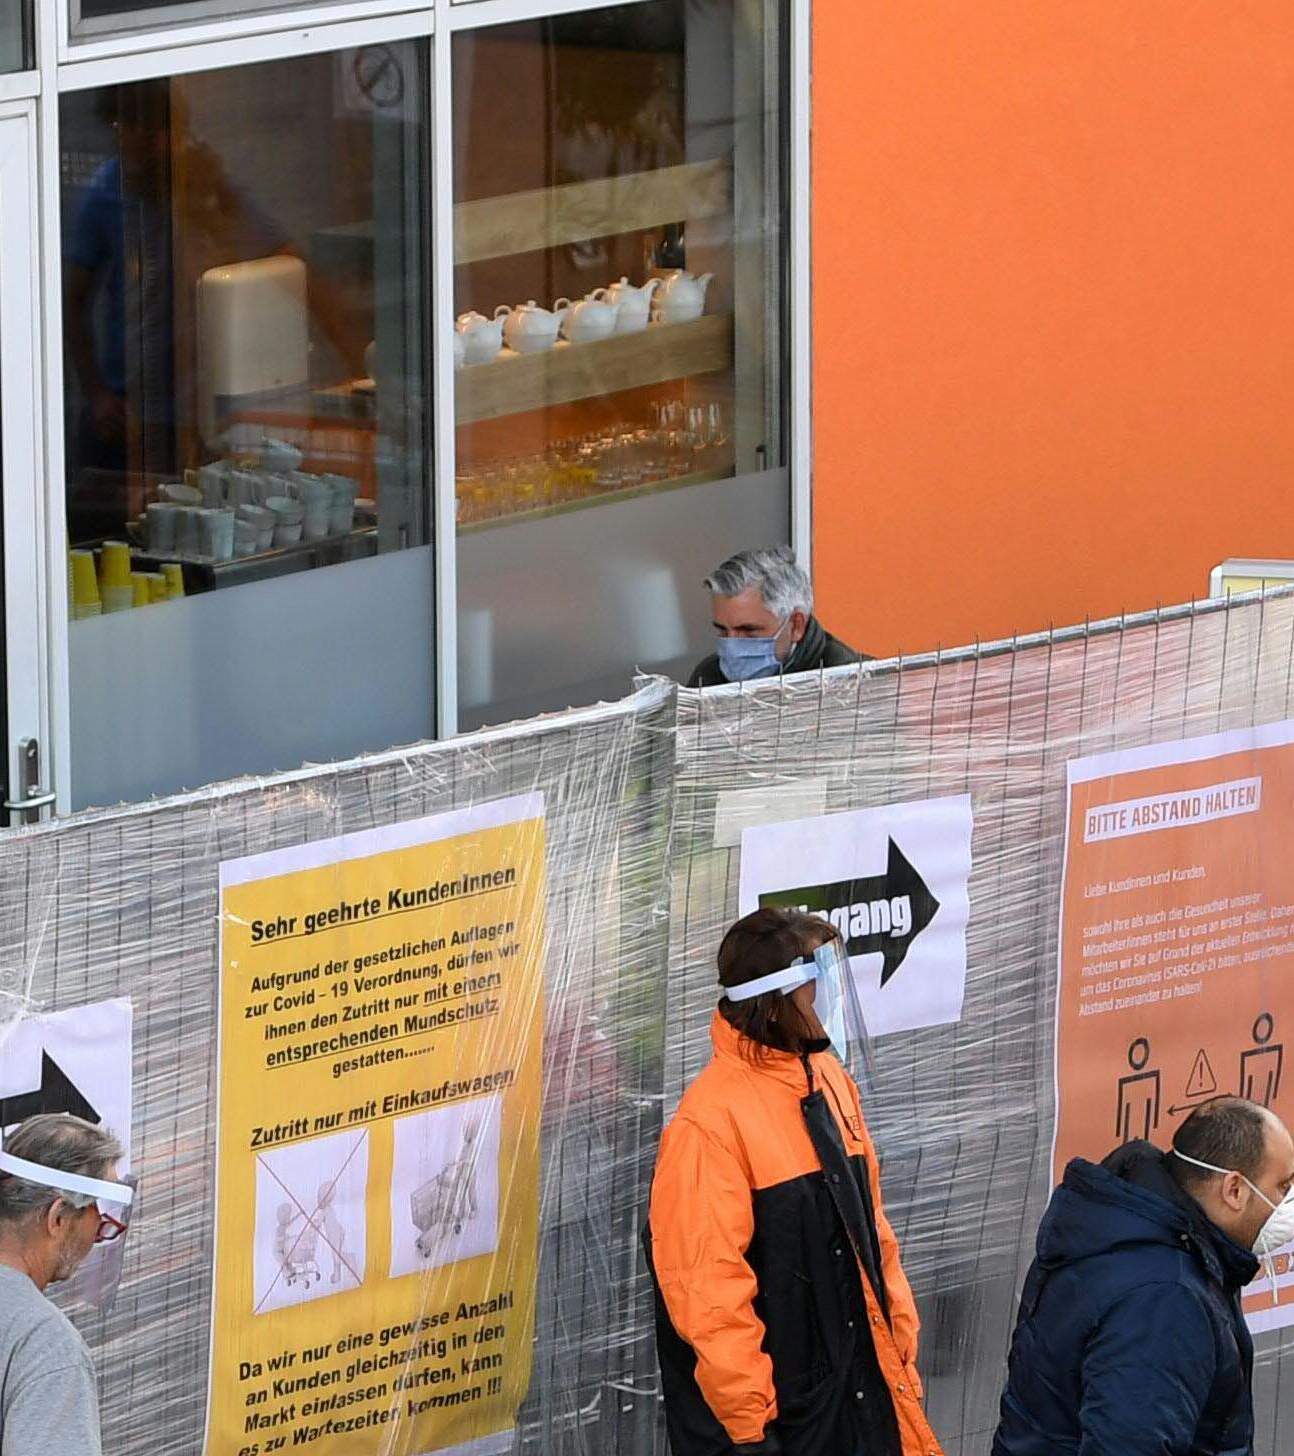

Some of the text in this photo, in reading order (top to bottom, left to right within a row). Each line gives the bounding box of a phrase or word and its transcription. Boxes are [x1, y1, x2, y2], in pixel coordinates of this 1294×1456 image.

[1087, 785, 1256, 836] BITTE ABSTAND HALTEN
[251, 916, 297, 941] Sehr
[305, 897, 381, 935] geehrte
[1084, 884, 1107, 898] Liebe
[1153, 870, 1171, 884] und
[245, 1002, 269, 1018] zur
[273, 988, 315, 1011] Covid
[331, 980, 349, 998] 19
[354, 963, 442, 993] Verordnung,
[447, 949, 493, 971] dürfen
[498, 941, 521, 958] wir
[251, 921, 514, 993] Aufgrund der gesetzlichen Auflagen
[266, 998, 499, 1066] entsprechenden Mundschutz
[311, 1013, 338, 1029] den
[342, 998, 390, 1022] Zutritt
[395, 993, 419, 1009] nur
[424, 982, 448, 1003] mit
[453, 972, 501, 995] einem
[251, 1069, 514, 1147] Zutritt nur mit Einkaufswagen
[239, 1362, 262, 1380] Da
[267, 1351, 297, 1371] wir
[302, 1344, 332, 1363] nur
[336, 1332, 374, 1353] eine
[455, 1290, 513, 1321] Anzahl
[245, 1324, 505, 1406] an Kunden gleichzeitig in den
[244, 1353, 503, 1433] Markt einlassen dürfen, kann
[264, 1435, 286, 1452] zu
[408, 1385, 481, 1417] kommen
[487, 1376, 503, 1396] !!!
